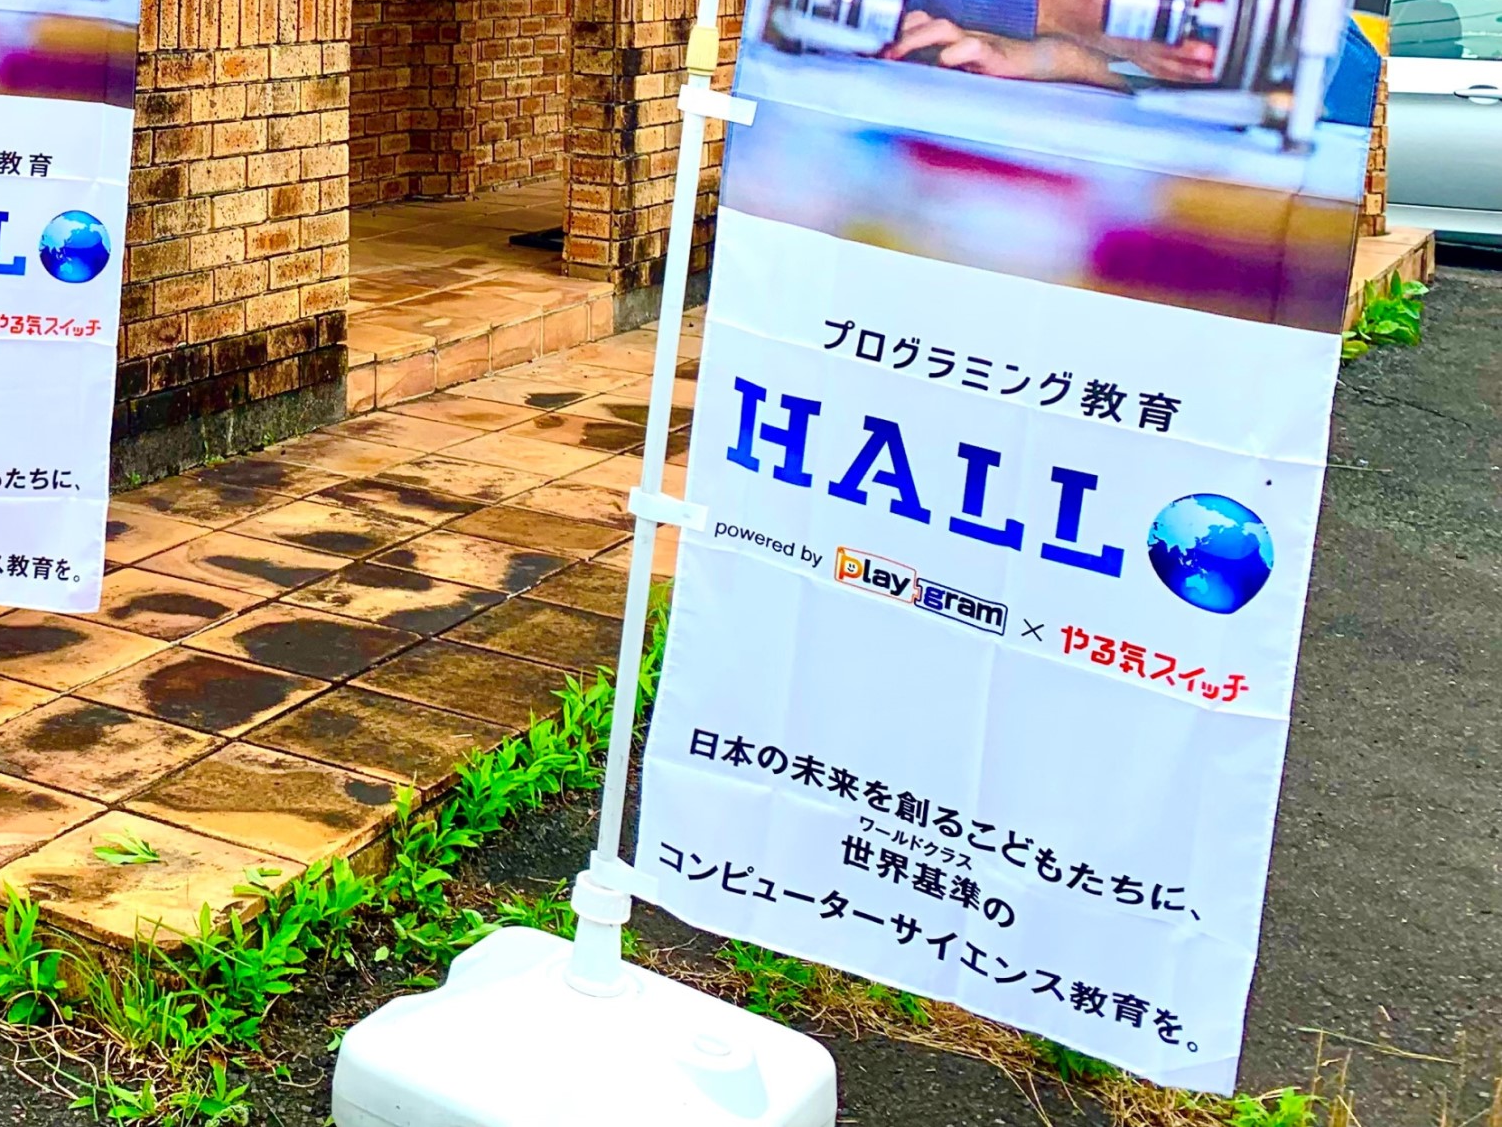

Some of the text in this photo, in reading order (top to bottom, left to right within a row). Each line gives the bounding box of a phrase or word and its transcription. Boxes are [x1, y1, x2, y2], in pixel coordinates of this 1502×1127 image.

[823, 319, 1182, 434] プログラミング教育
[714, 519, 795, 559] powered
[800, 547, 823, 571] by
[1060, 624, 1250, 704] やる気スイッチ
[689, 727, 1202, 922] 日本の未来を創るこどもたちに、
[840, 834, 1016, 930] 世界基準の
[859, 815, 973, 871] ワールドクラス
[658, 841, 1200, 1055] コンピューターサイエンス教育を。
